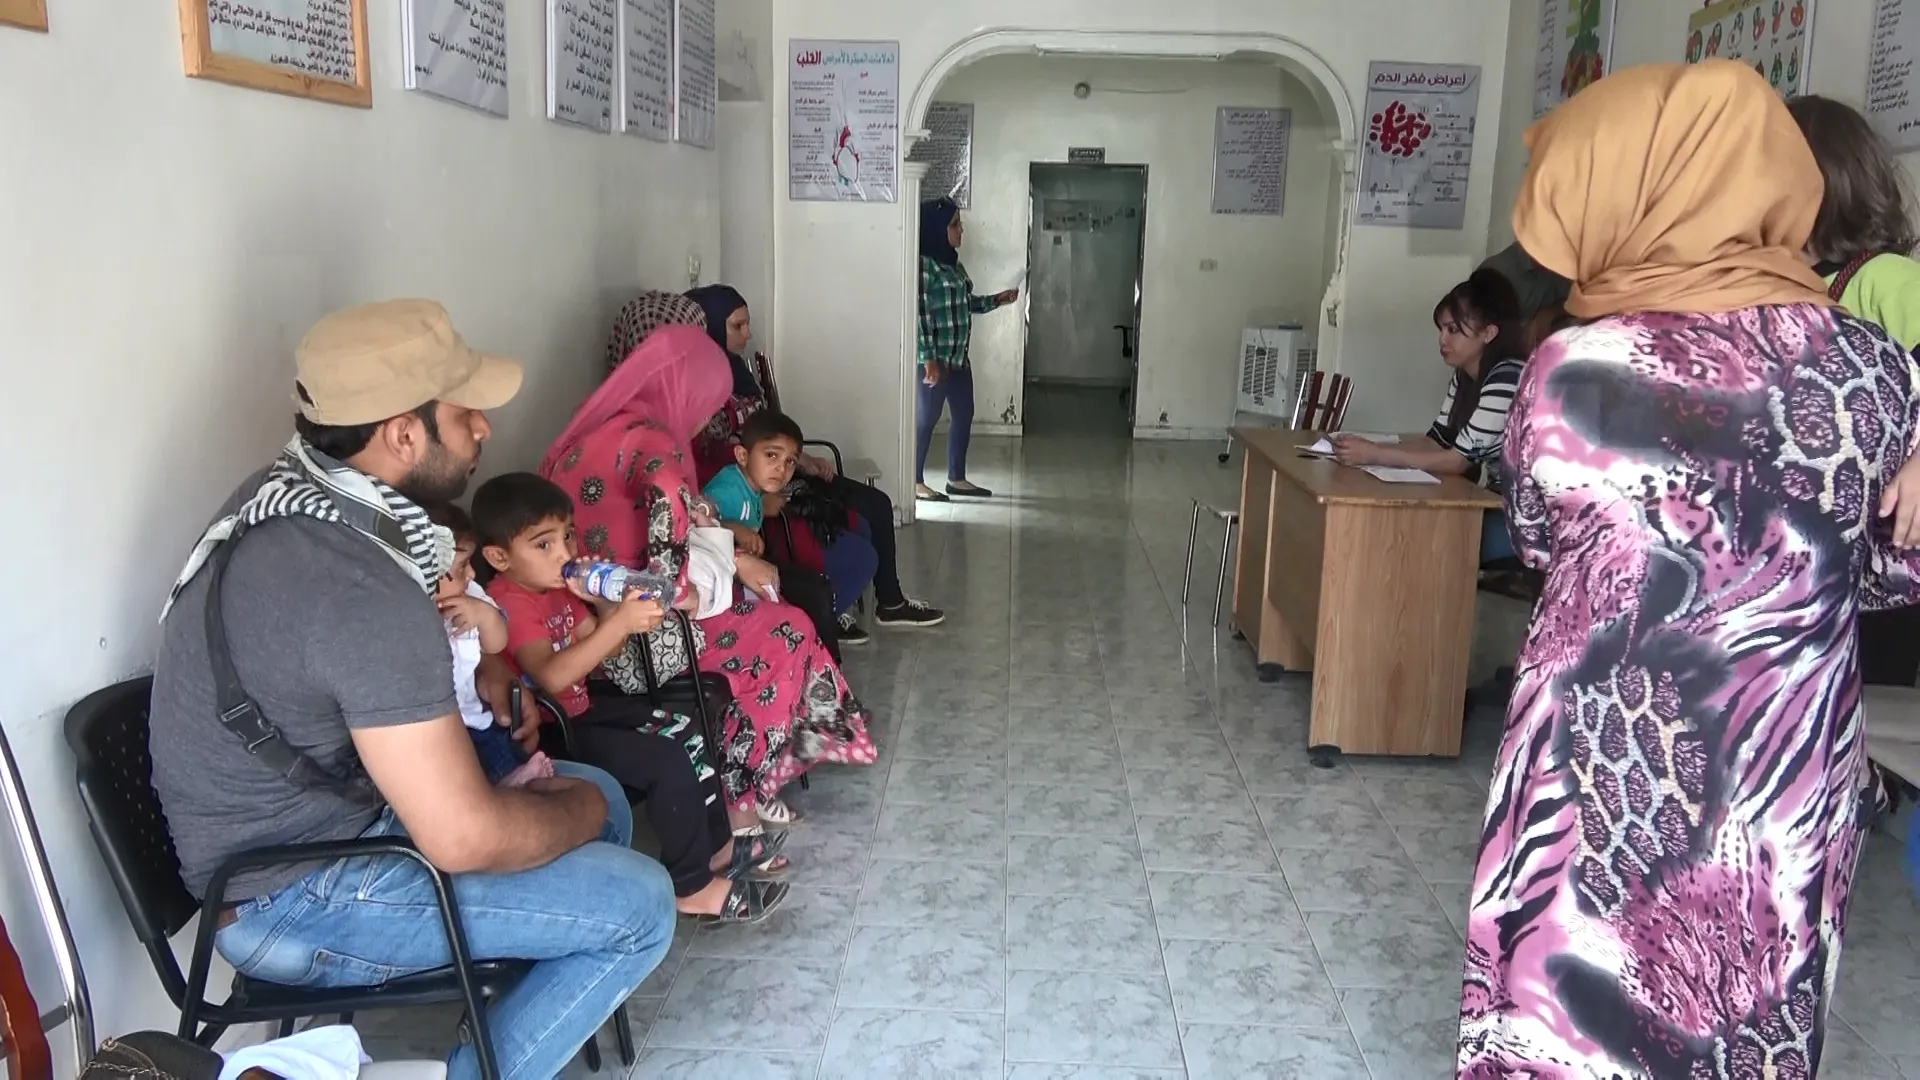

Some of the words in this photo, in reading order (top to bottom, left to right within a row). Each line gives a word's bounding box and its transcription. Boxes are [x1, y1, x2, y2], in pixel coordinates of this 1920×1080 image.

[796, 50, 822, 68] القلب
[1374, 71, 1401, 85] الدم
[1402, 72, 1426, 86] فقر
